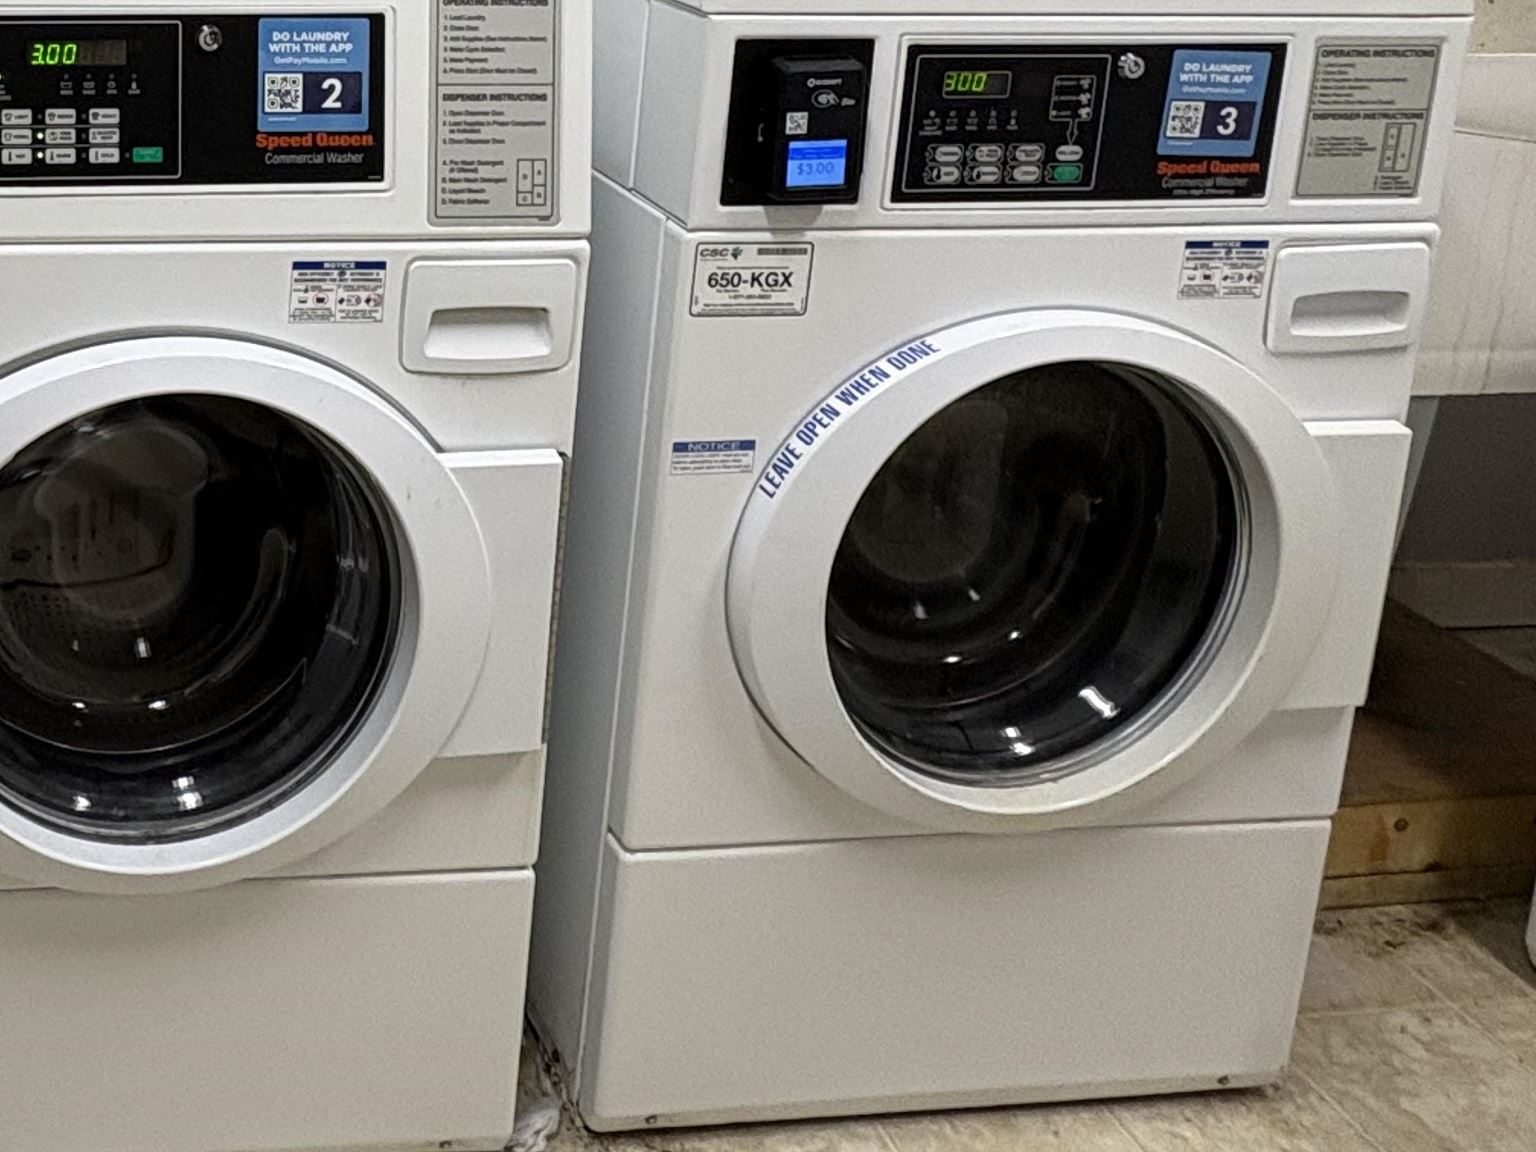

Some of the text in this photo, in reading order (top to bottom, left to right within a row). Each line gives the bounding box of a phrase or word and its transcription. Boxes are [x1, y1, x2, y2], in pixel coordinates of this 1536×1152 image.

[272, 31, 350, 42] DO LAUNDRY
[269, 43, 353, 53] WITH THE APP
[1184, 63, 1253, 73] DO LAUNDRY
[1179, 73, 1254, 84] WITH THE APP
[321, 78, 343, 108] 2
[1216, 106, 1238, 136] 3
[256, 132, 374, 150] Speed Queen
[265, 152, 364, 165] Commercial Washer
[1157, 160, 1260, 177] Speed Queen
[1162, 177, 1214, 188] Commercial
[700, 247, 730, 257] CSC
[707, 271, 794, 288] 650-KGX
[759, 443, 804, 499] LEAVE
[796, 403, 841, 447] OPEN
[835, 366, 891, 407] WHEN
[886, 339, 941, 371] DONE
[688, 442, 741, 451] NOTICE
